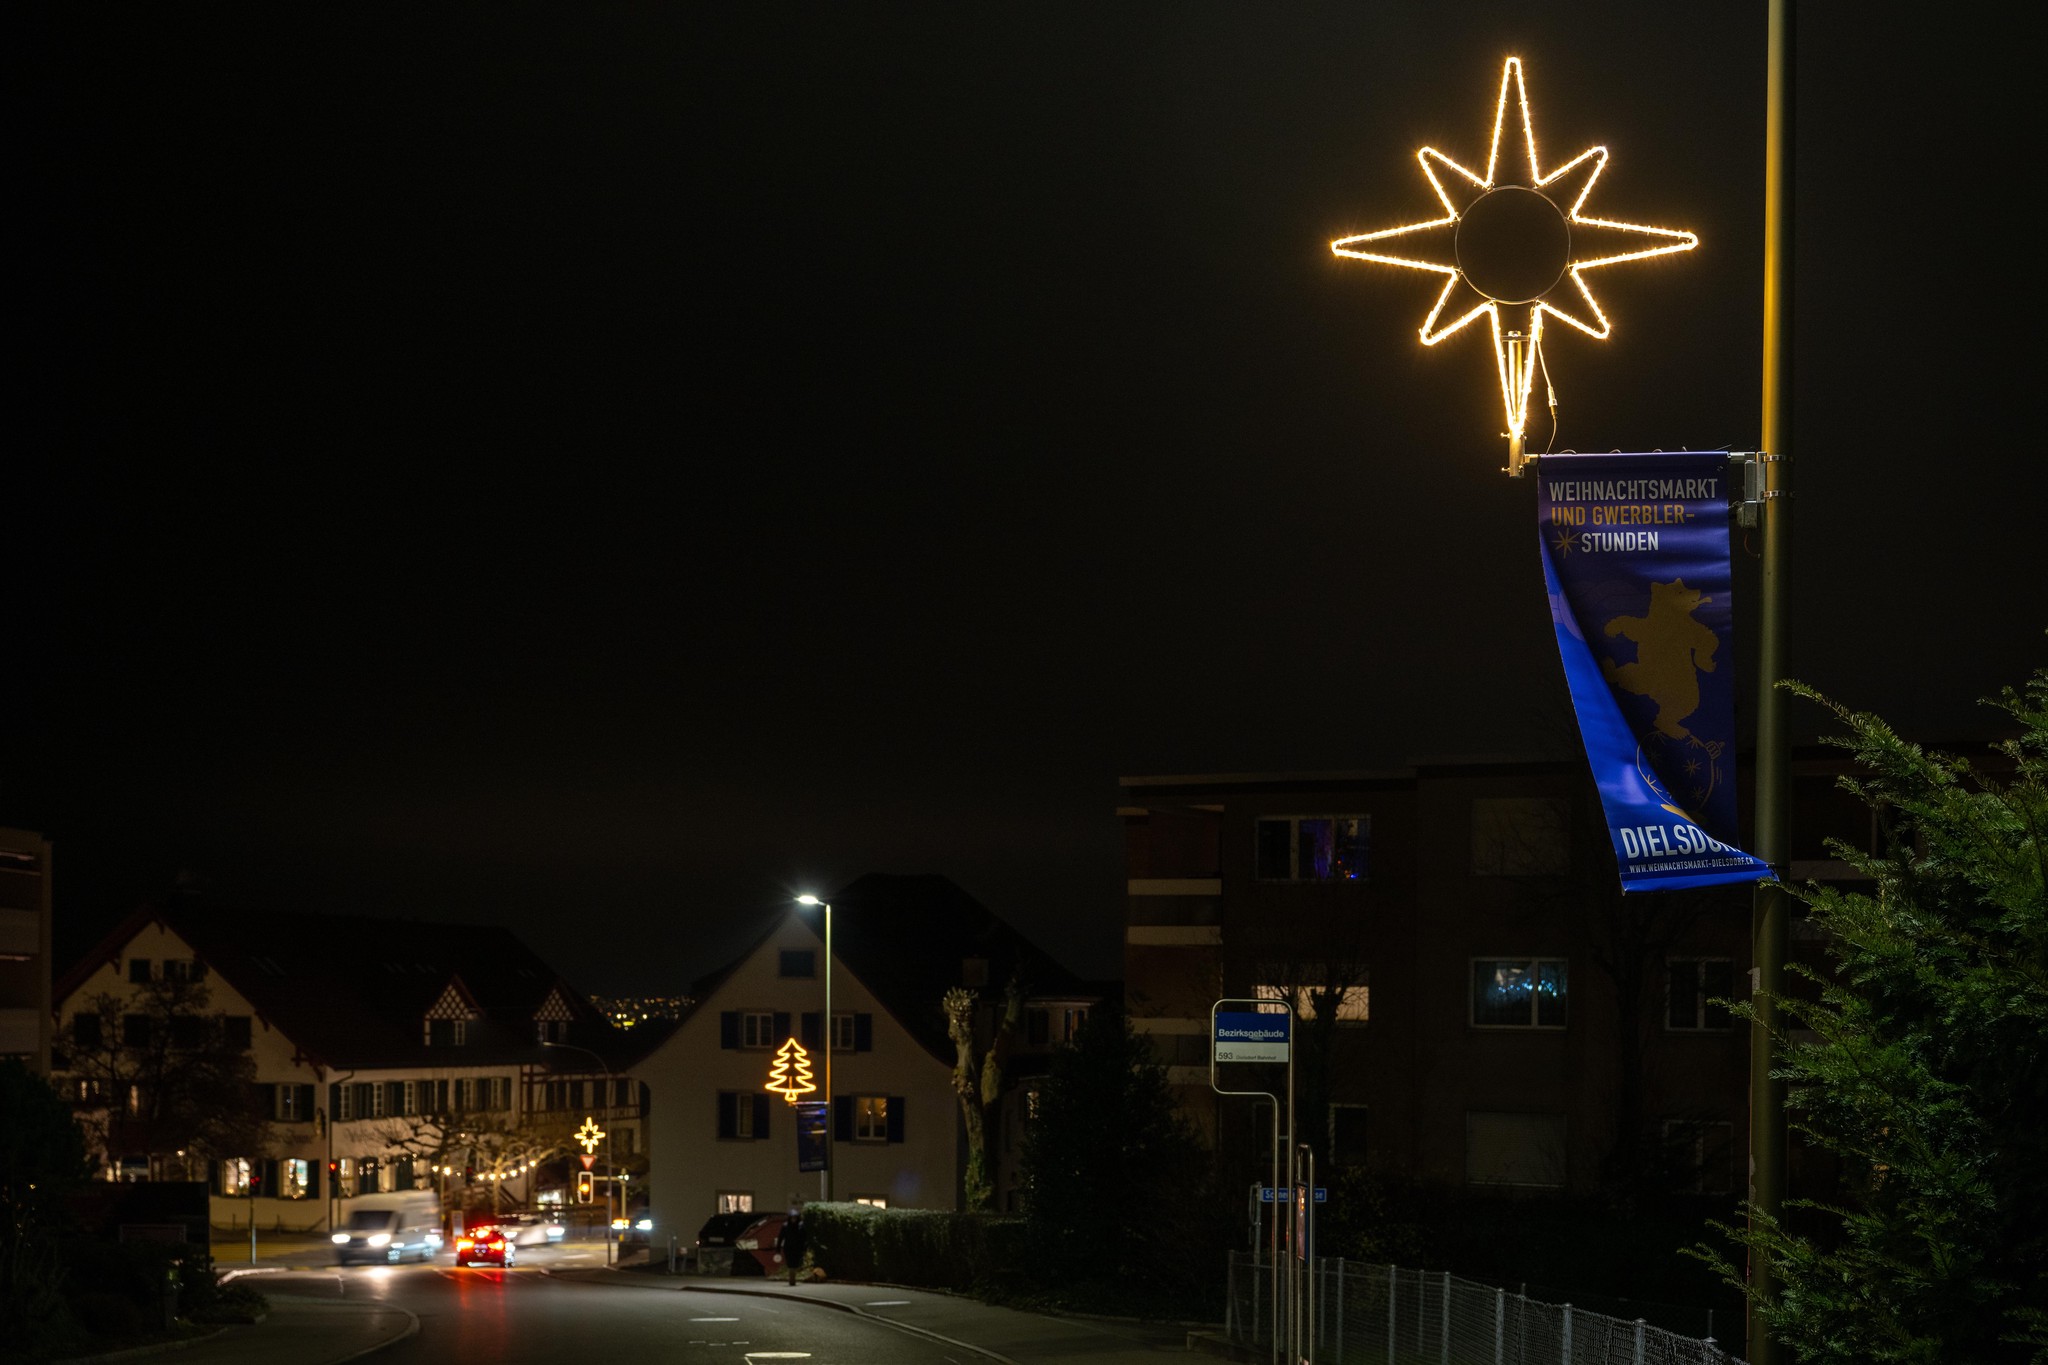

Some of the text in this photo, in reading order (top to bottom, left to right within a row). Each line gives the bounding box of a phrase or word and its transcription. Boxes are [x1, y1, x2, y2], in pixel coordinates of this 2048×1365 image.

[1549, 479, 1718, 501] WEIHNACHTSMARKT
[1551, 505, 1695, 526] UND GWERBLER-
[1581, 531, 1659, 553] STUNDEN
[1630, 857, 1754, 874] WWW.WEIHNACHTSMARKT-DIELSDORF.CH
[1218, 1028, 1284, 1039] Bezirksgebäude
[1218, 1052, 1233, 1060] 593
